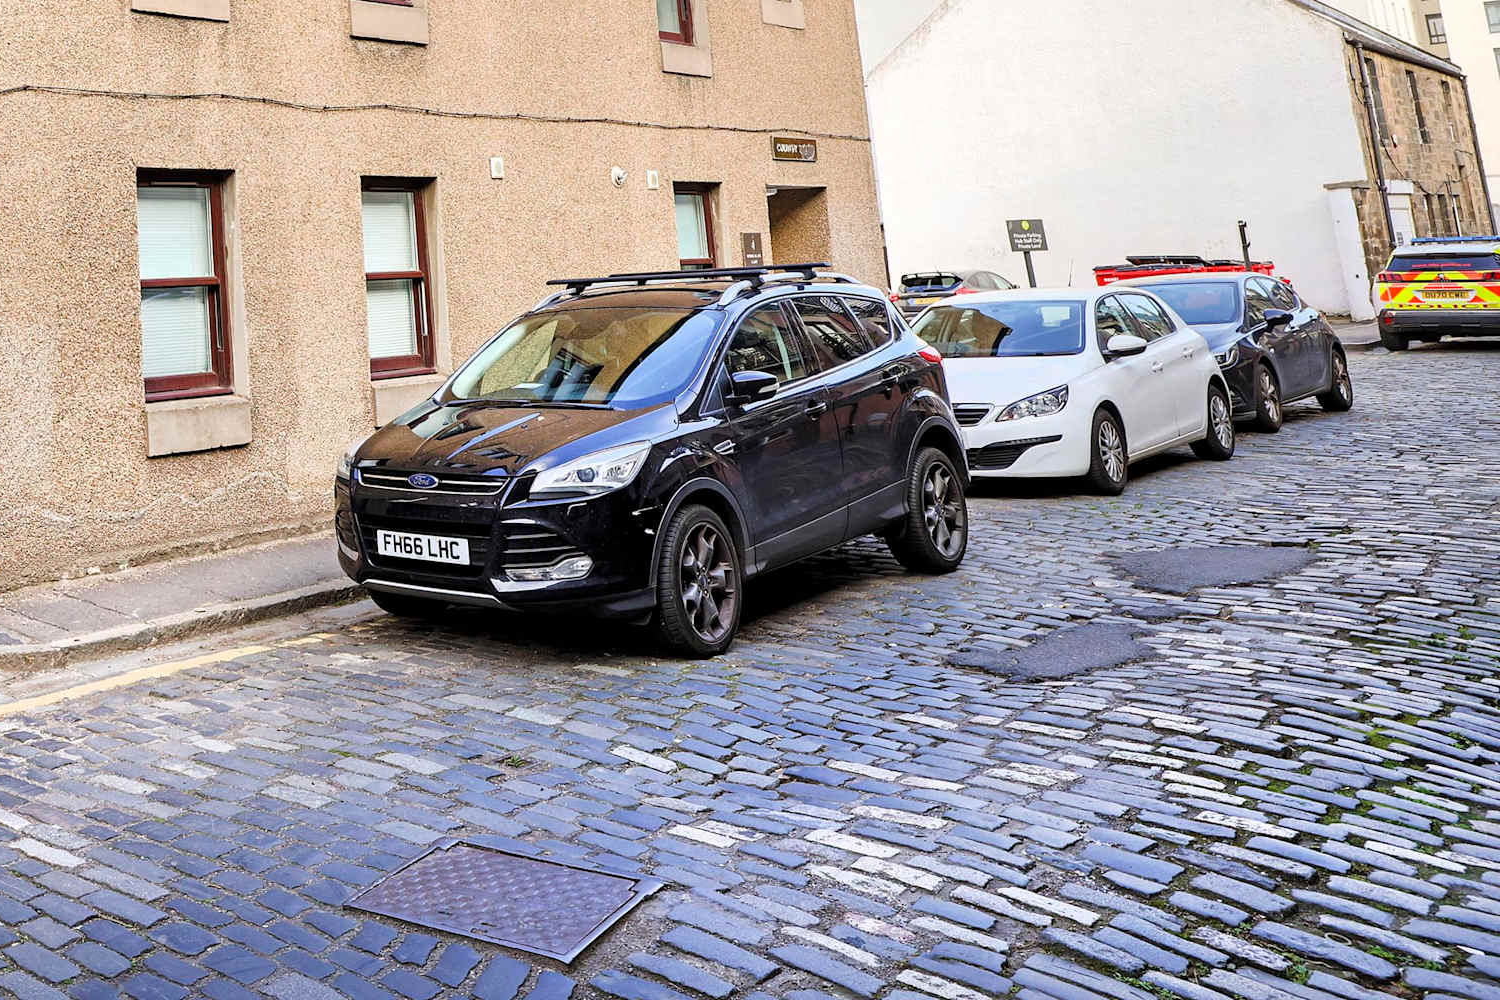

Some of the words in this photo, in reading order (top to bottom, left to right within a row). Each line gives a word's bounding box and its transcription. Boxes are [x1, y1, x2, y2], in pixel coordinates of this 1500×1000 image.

[413, 476, 431, 486] Ford
[383, 533, 423, 556] FH66
[427, 538, 460, 560] LHC
